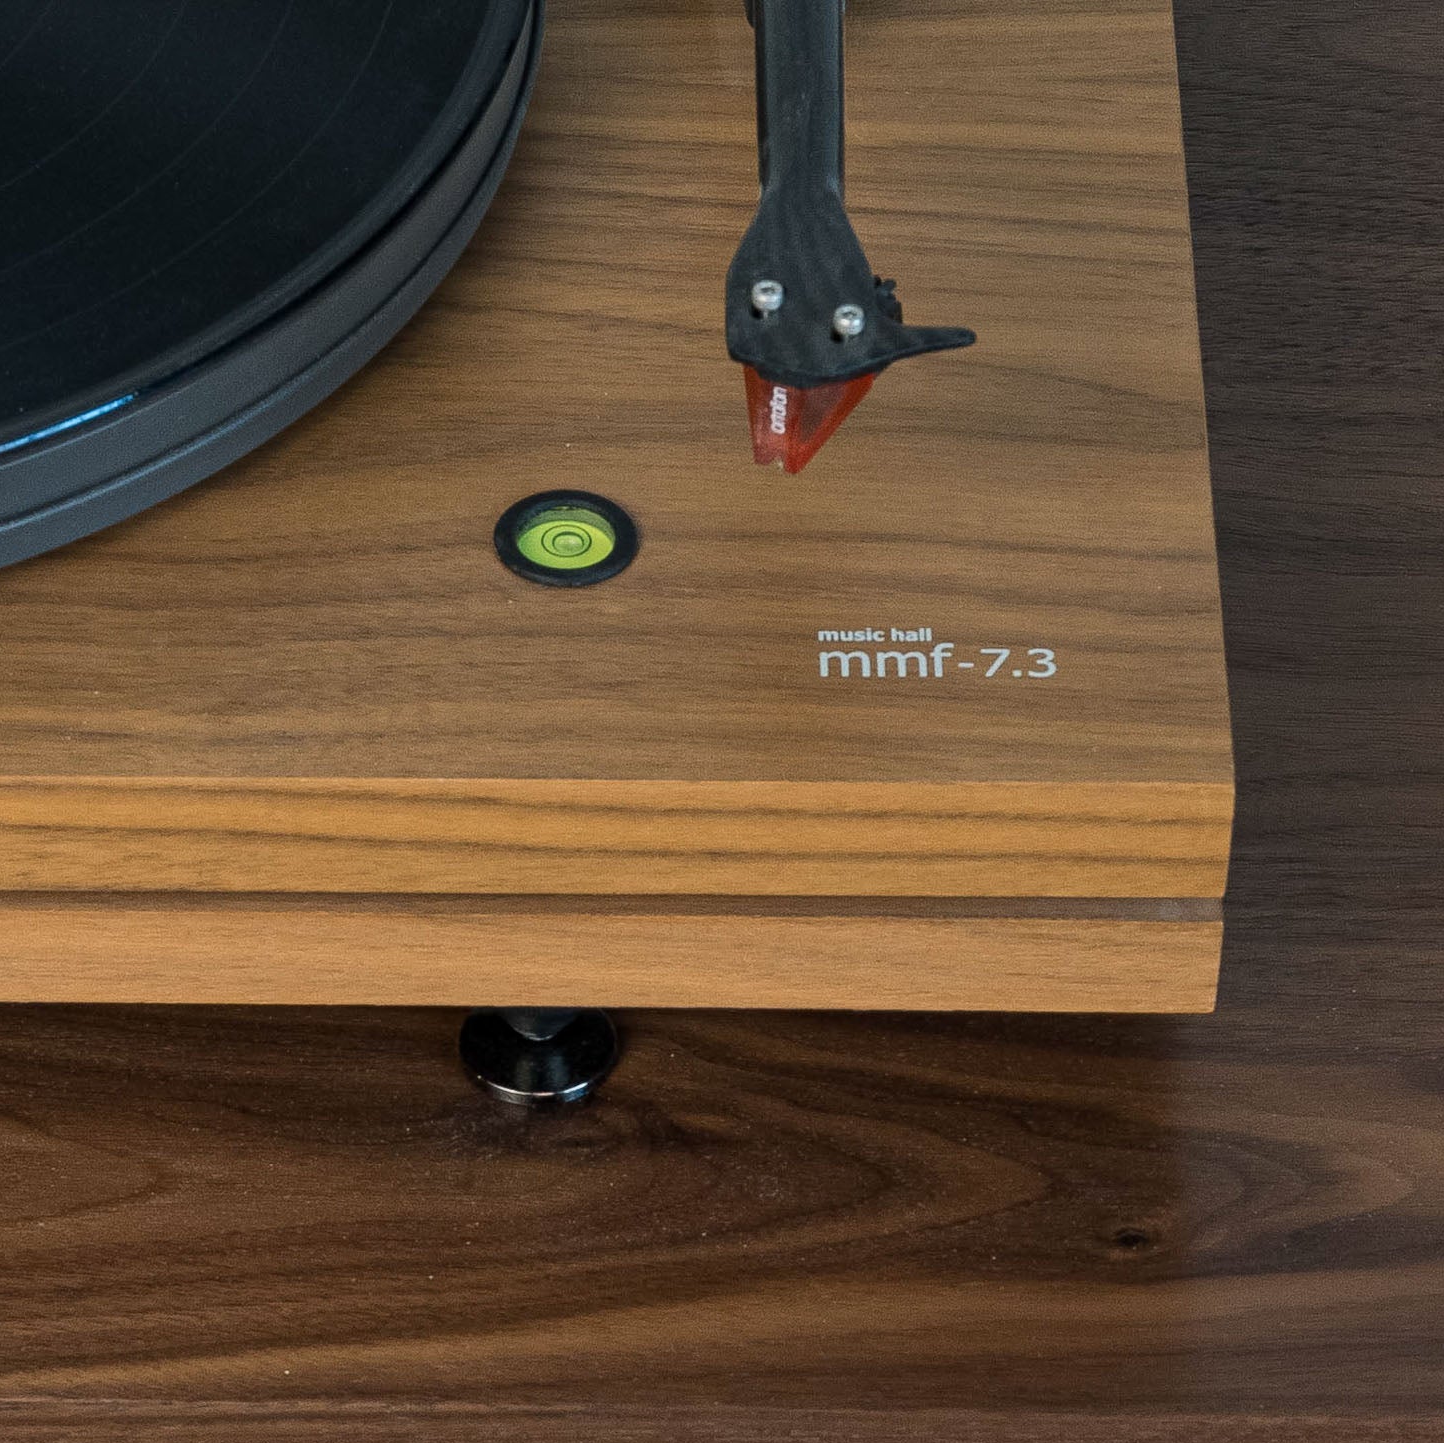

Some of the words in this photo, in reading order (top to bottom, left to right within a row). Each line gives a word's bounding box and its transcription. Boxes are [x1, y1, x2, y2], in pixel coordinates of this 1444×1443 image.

[817, 627, 886, 642] music
[890, 627, 933, 642] hall
[818, 642, 1058, 678] mmf-7.3
